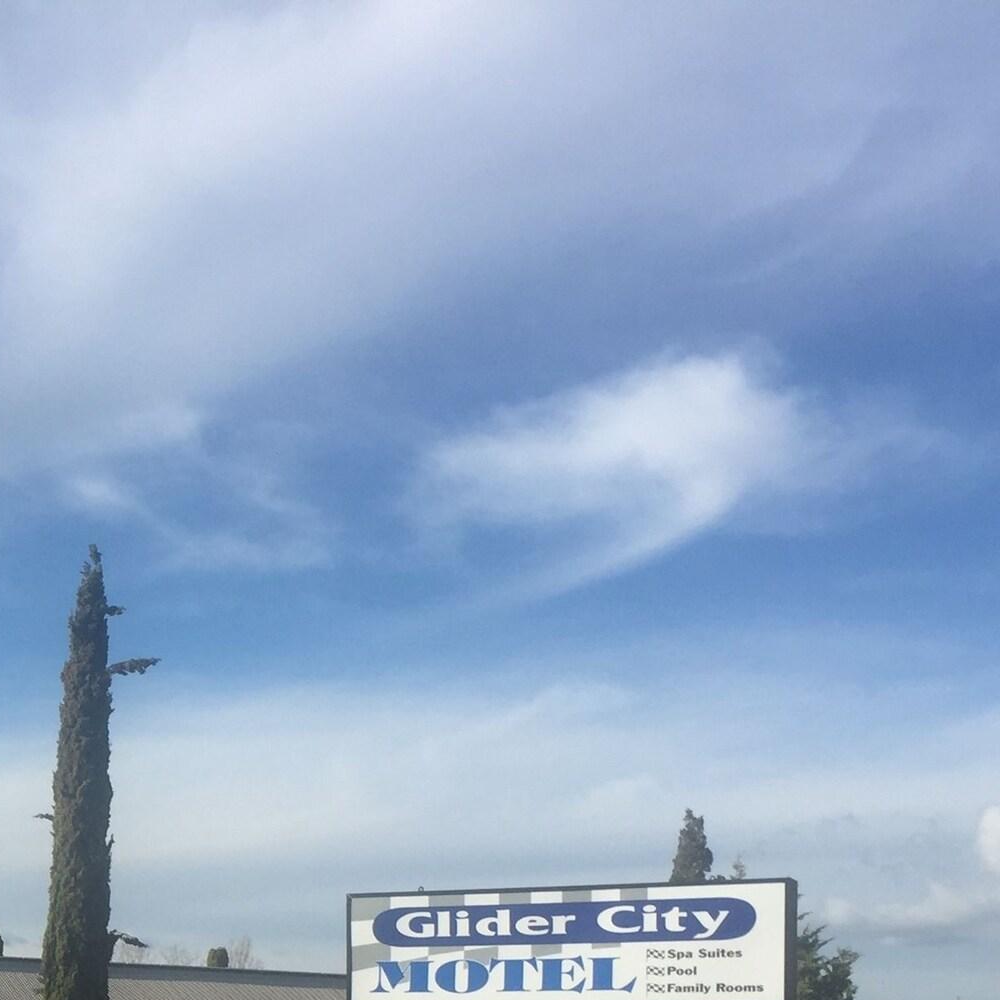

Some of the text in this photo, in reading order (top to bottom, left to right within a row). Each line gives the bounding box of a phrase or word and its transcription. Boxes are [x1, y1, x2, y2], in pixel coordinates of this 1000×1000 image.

[396, 903, 731, 940] Glider City
[667, 948, 743, 960] Spa Suites
[369, 956, 638, 994] MOTEL
[667, 966, 697, 976] Pool
[667, 983, 764, 994] Family Rooms
